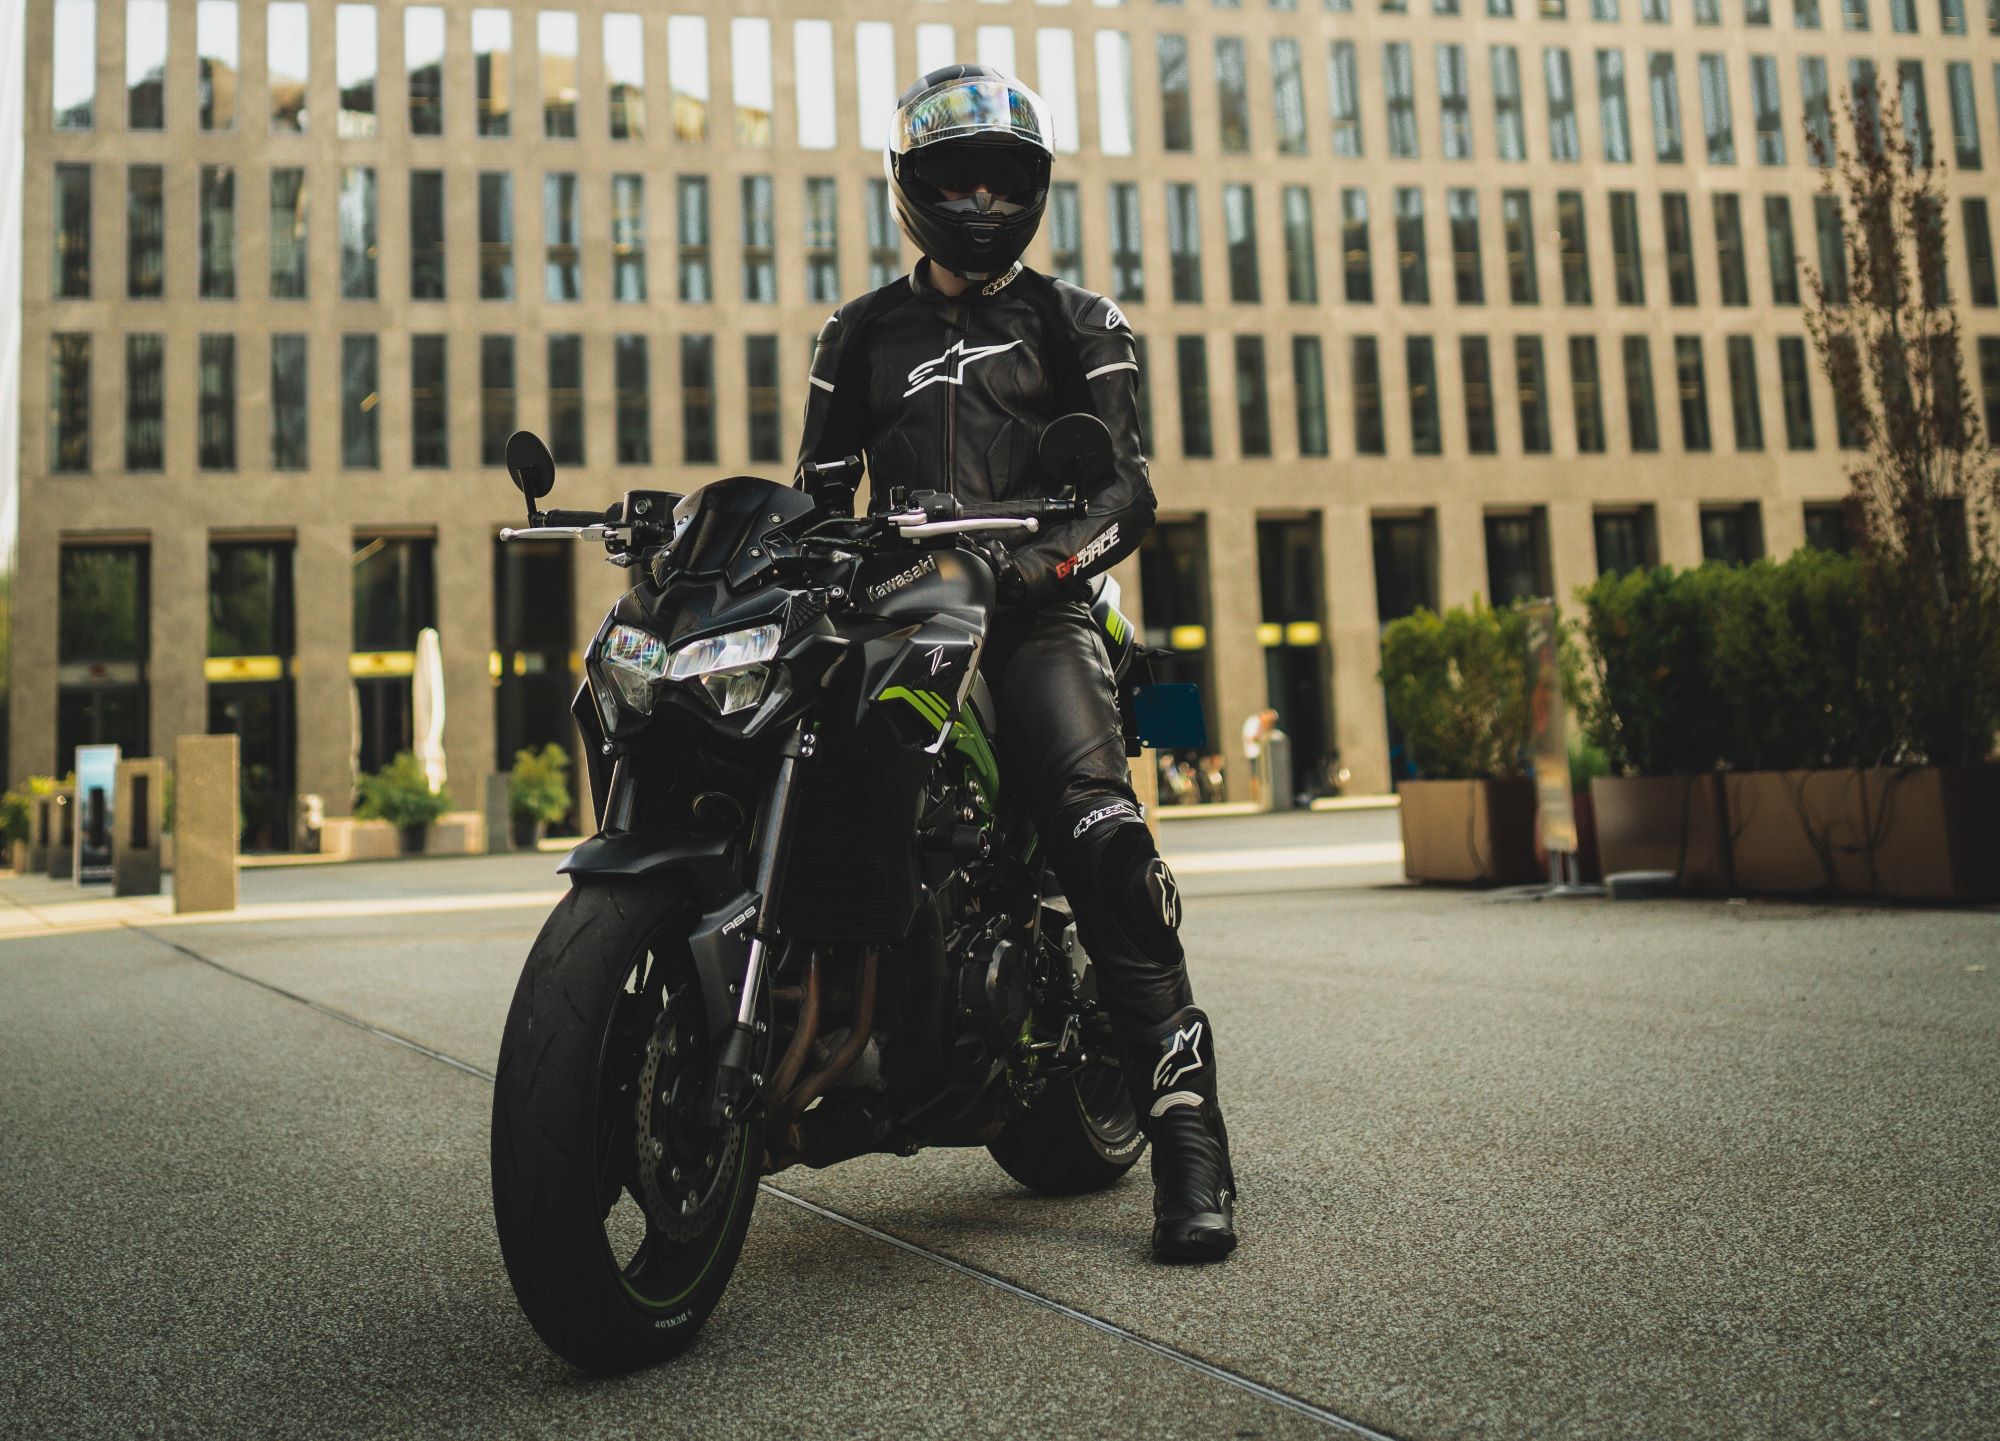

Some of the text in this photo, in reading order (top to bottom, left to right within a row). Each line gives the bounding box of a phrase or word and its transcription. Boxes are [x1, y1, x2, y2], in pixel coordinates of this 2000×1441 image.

[866, 555, 936, 602] Kawasaki
[722, 906, 756, 935] ABS
[654, 1312, 688, 1329] DUNLOP
